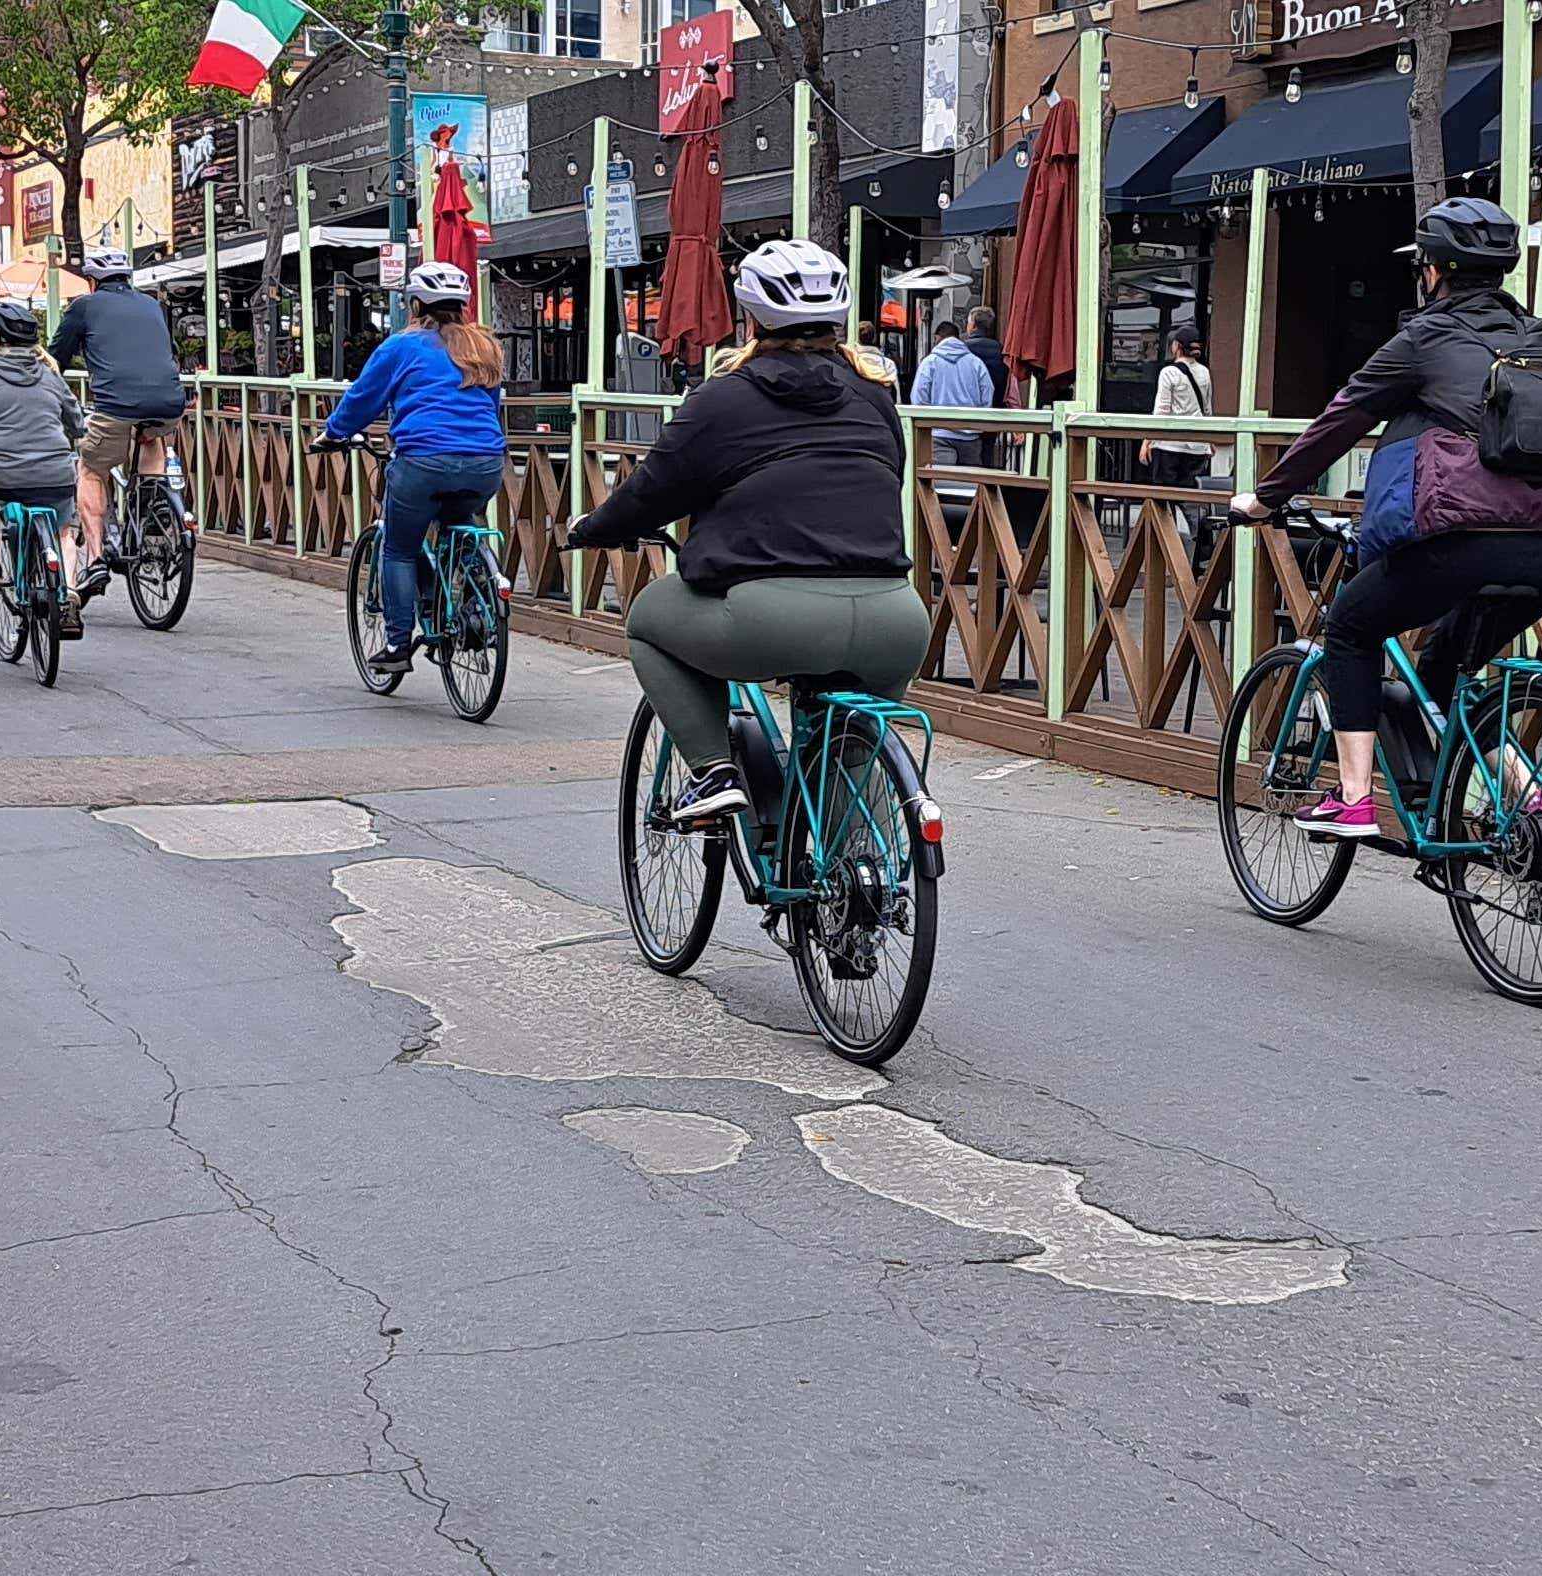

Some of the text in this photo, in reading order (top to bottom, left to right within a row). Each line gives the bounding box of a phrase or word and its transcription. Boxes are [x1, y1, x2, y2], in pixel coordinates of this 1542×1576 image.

[1280, 0, 1363, 42] Buon
[1209, 157, 1364, 197] Ristornte Italiano
[641, 344, 649, 355] P
